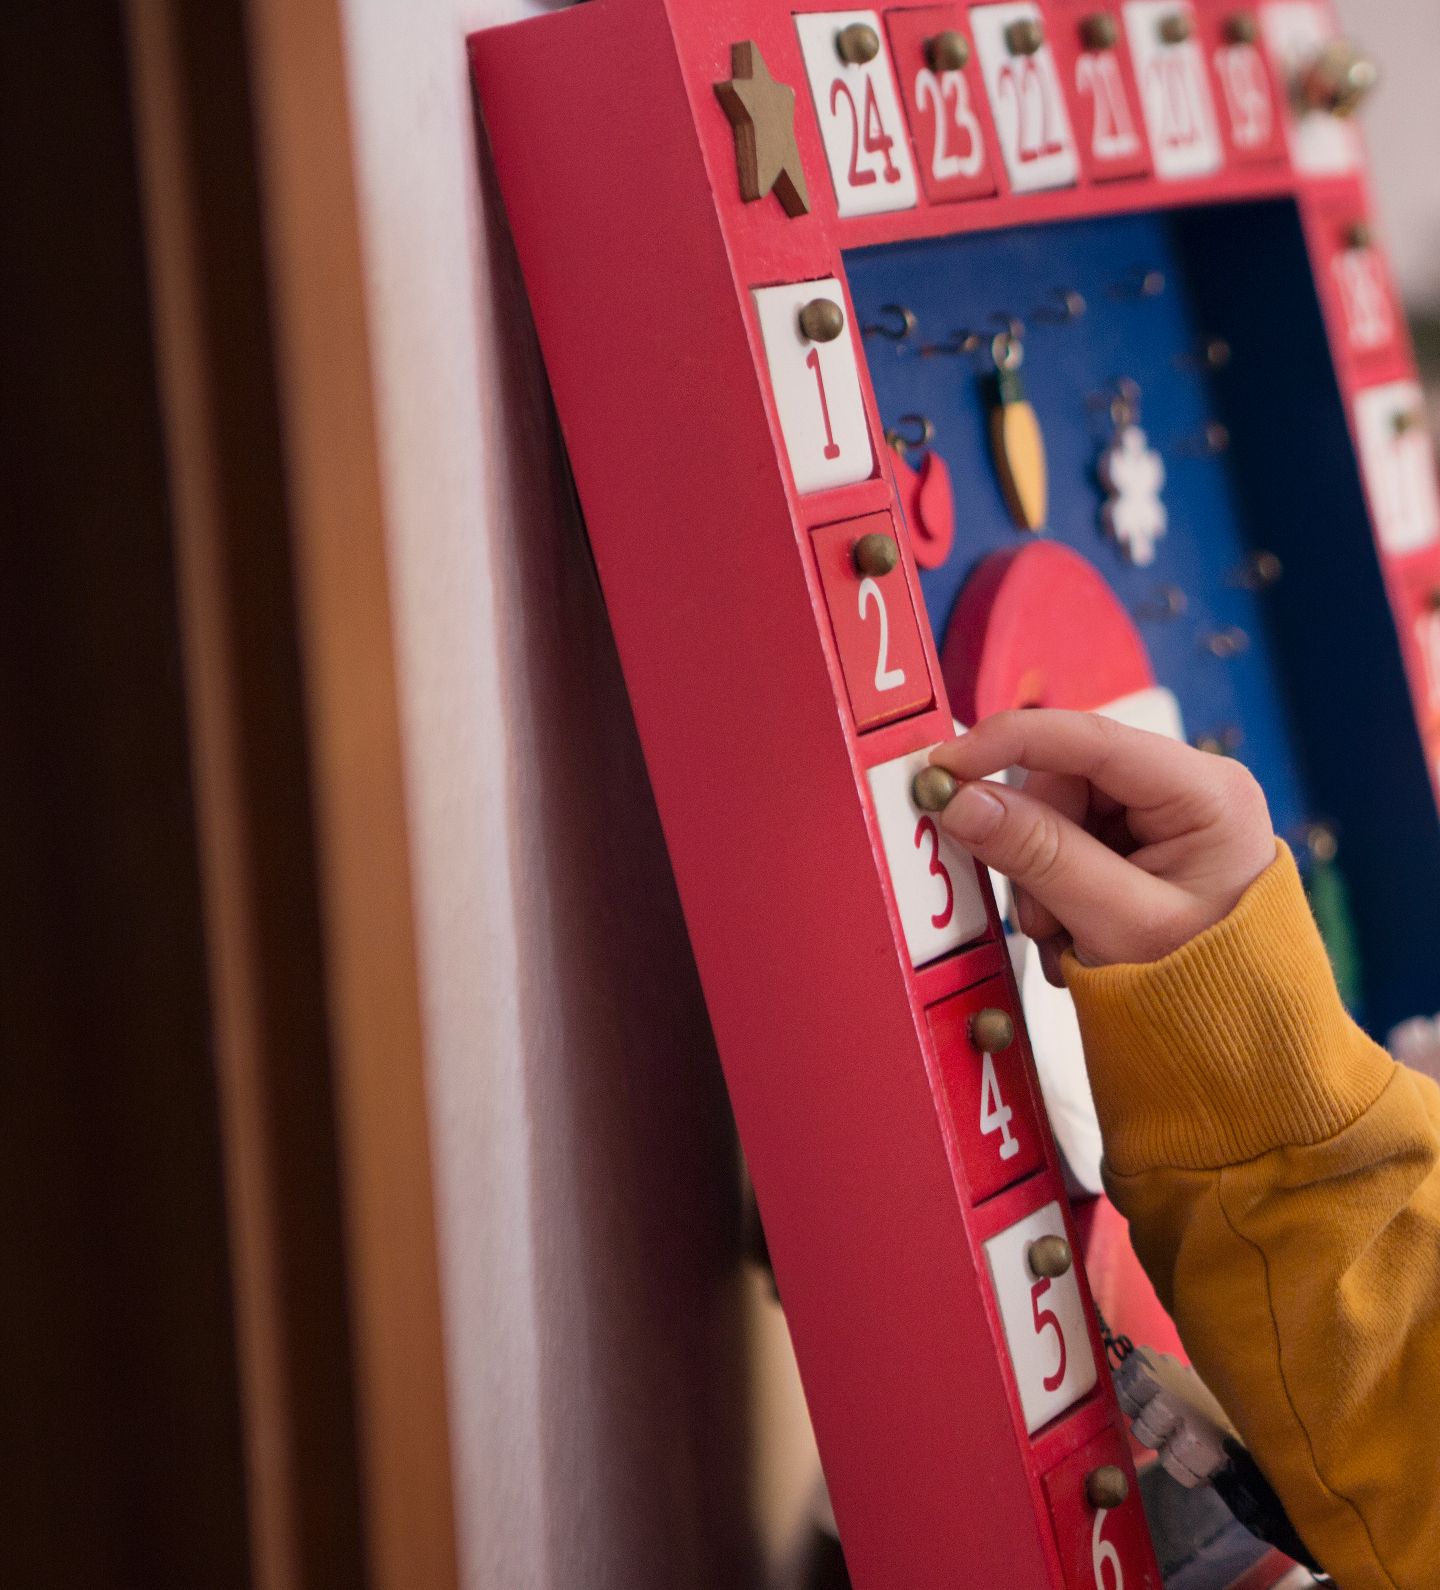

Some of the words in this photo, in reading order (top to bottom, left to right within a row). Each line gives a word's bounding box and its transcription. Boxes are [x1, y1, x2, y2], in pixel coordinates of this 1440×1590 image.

[829, 73, 901, 187] 24
[915, 68, 984, 181] 23
[998, 57, 1062, 162] 22
[1075, 51, 1141, 160] 21
[806, 347, 841, 460] 1
[858, 578, 906, 692] 2
[914, 815, 954, 930] 3
[979, 1052, 1019, 1161] 4
[1030, 1277, 1066, 1393] 5
[1092, 1508, 1124, 1590] 6
